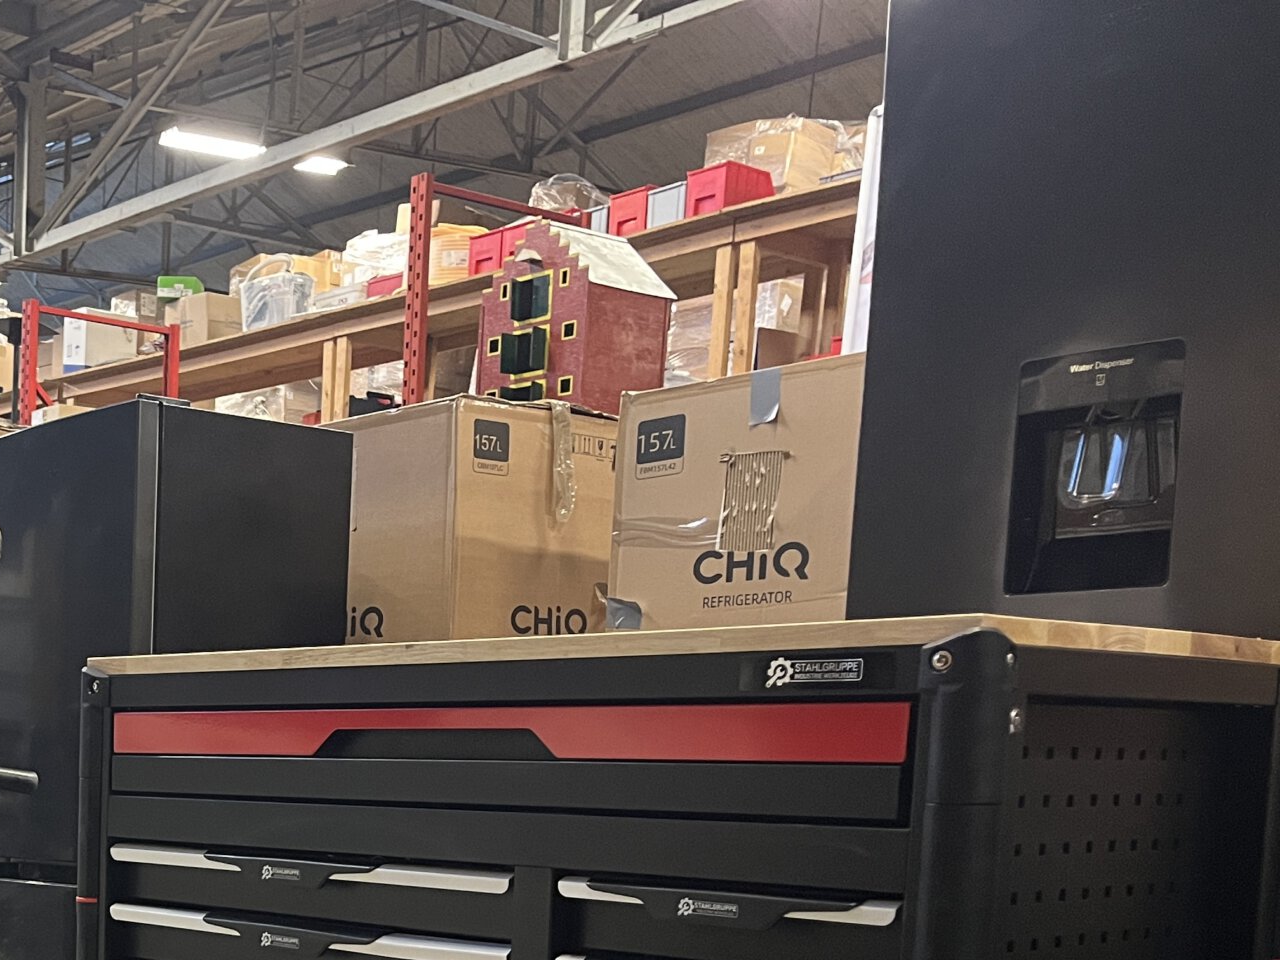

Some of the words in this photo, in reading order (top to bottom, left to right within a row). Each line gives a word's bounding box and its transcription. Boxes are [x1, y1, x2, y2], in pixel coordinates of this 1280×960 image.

[1069, 363, 1094, 373] Water
[1095, 357, 1135, 370] Dispenser
[475, 434, 503, 453] 157L
[639, 429, 677, 454] 157L
[702, 590, 793, 609] REFRIGERATOR
[350, 606, 384, 638] iQ
[795, 661, 859, 672] STAHLGRUPPE
